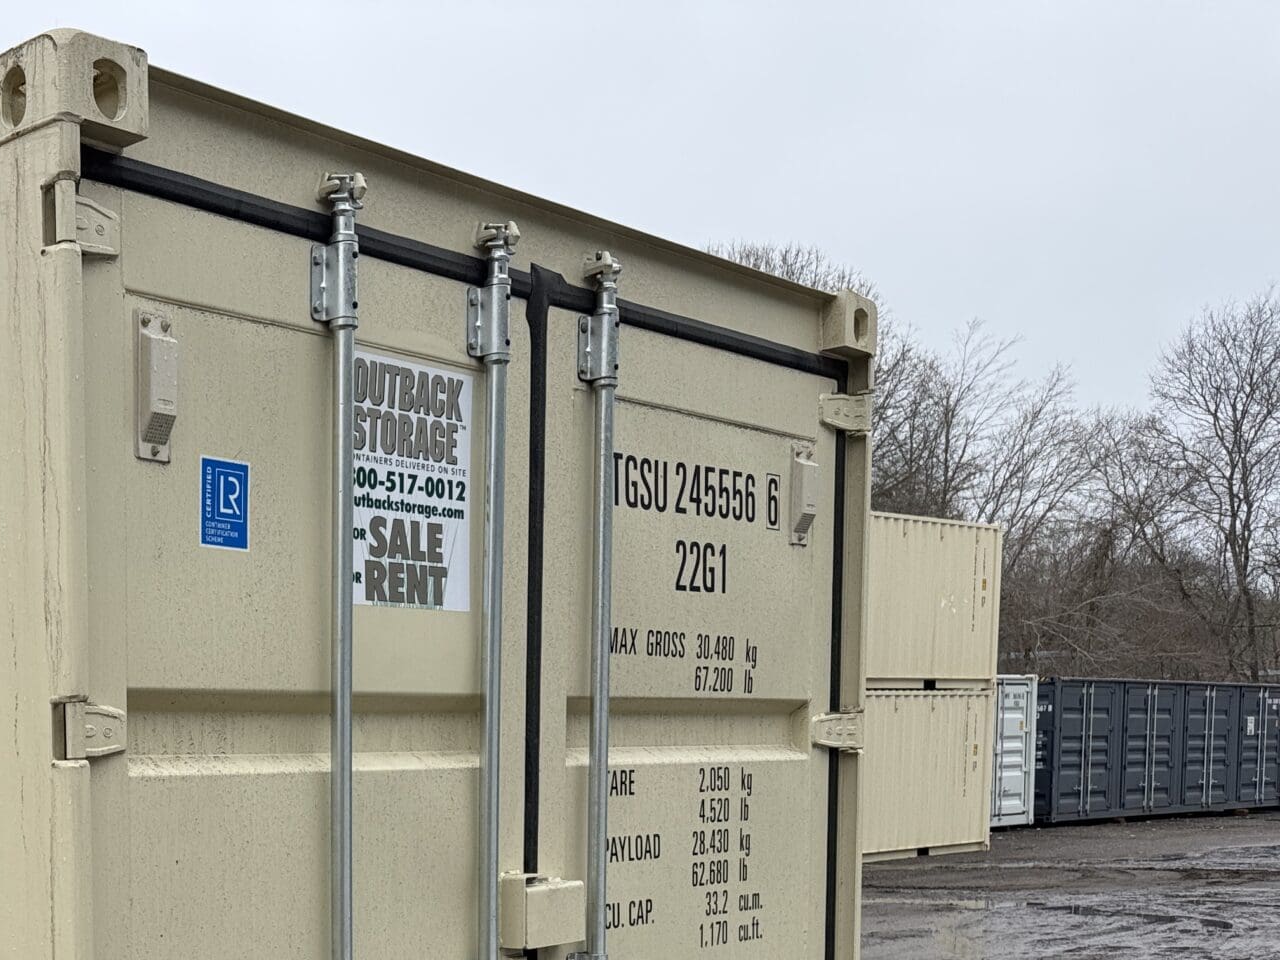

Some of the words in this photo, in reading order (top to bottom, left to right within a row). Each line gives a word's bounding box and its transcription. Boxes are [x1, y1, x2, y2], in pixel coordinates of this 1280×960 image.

[353, 357, 464, 422] OUTBACK
[353, 405, 458, 465] STORAGE
[353, 453, 393, 466] NTAINERS
[395, 459, 436, 473] DELIVERED
[438, 466, 449, 475] ON
[451, 468, 467, 478] SITE
[354, 492, 465, 520] utbackstorage.com
[613, 452, 668, 513] TGSU
[675, 462, 756, 523] 245556
[769, 478, 778, 526] 6
[353, 527, 367, 541] OR
[369, 515, 444, 563] SALE
[365, 559, 448, 606] RENT
[675, 539, 726, 594] 22G1
[609, 627, 638, 655] MAX
[646, 629, 686, 658] GROSS
[745, 638, 757, 669] kg
[743, 669, 753, 694] lb
[608, 770, 635, 796] ARE
[741, 766, 753, 797] kg
[740, 797, 749, 822] lb
[739, 827, 751, 857] kg
[739, 857, 748, 882] lb
[629, 898, 655, 927] CAP.
[705, 889, 728, 917] 33.2
[738, 892, 763, 912] cu.m.
[738, 916, 763, 942] cu.ft.
